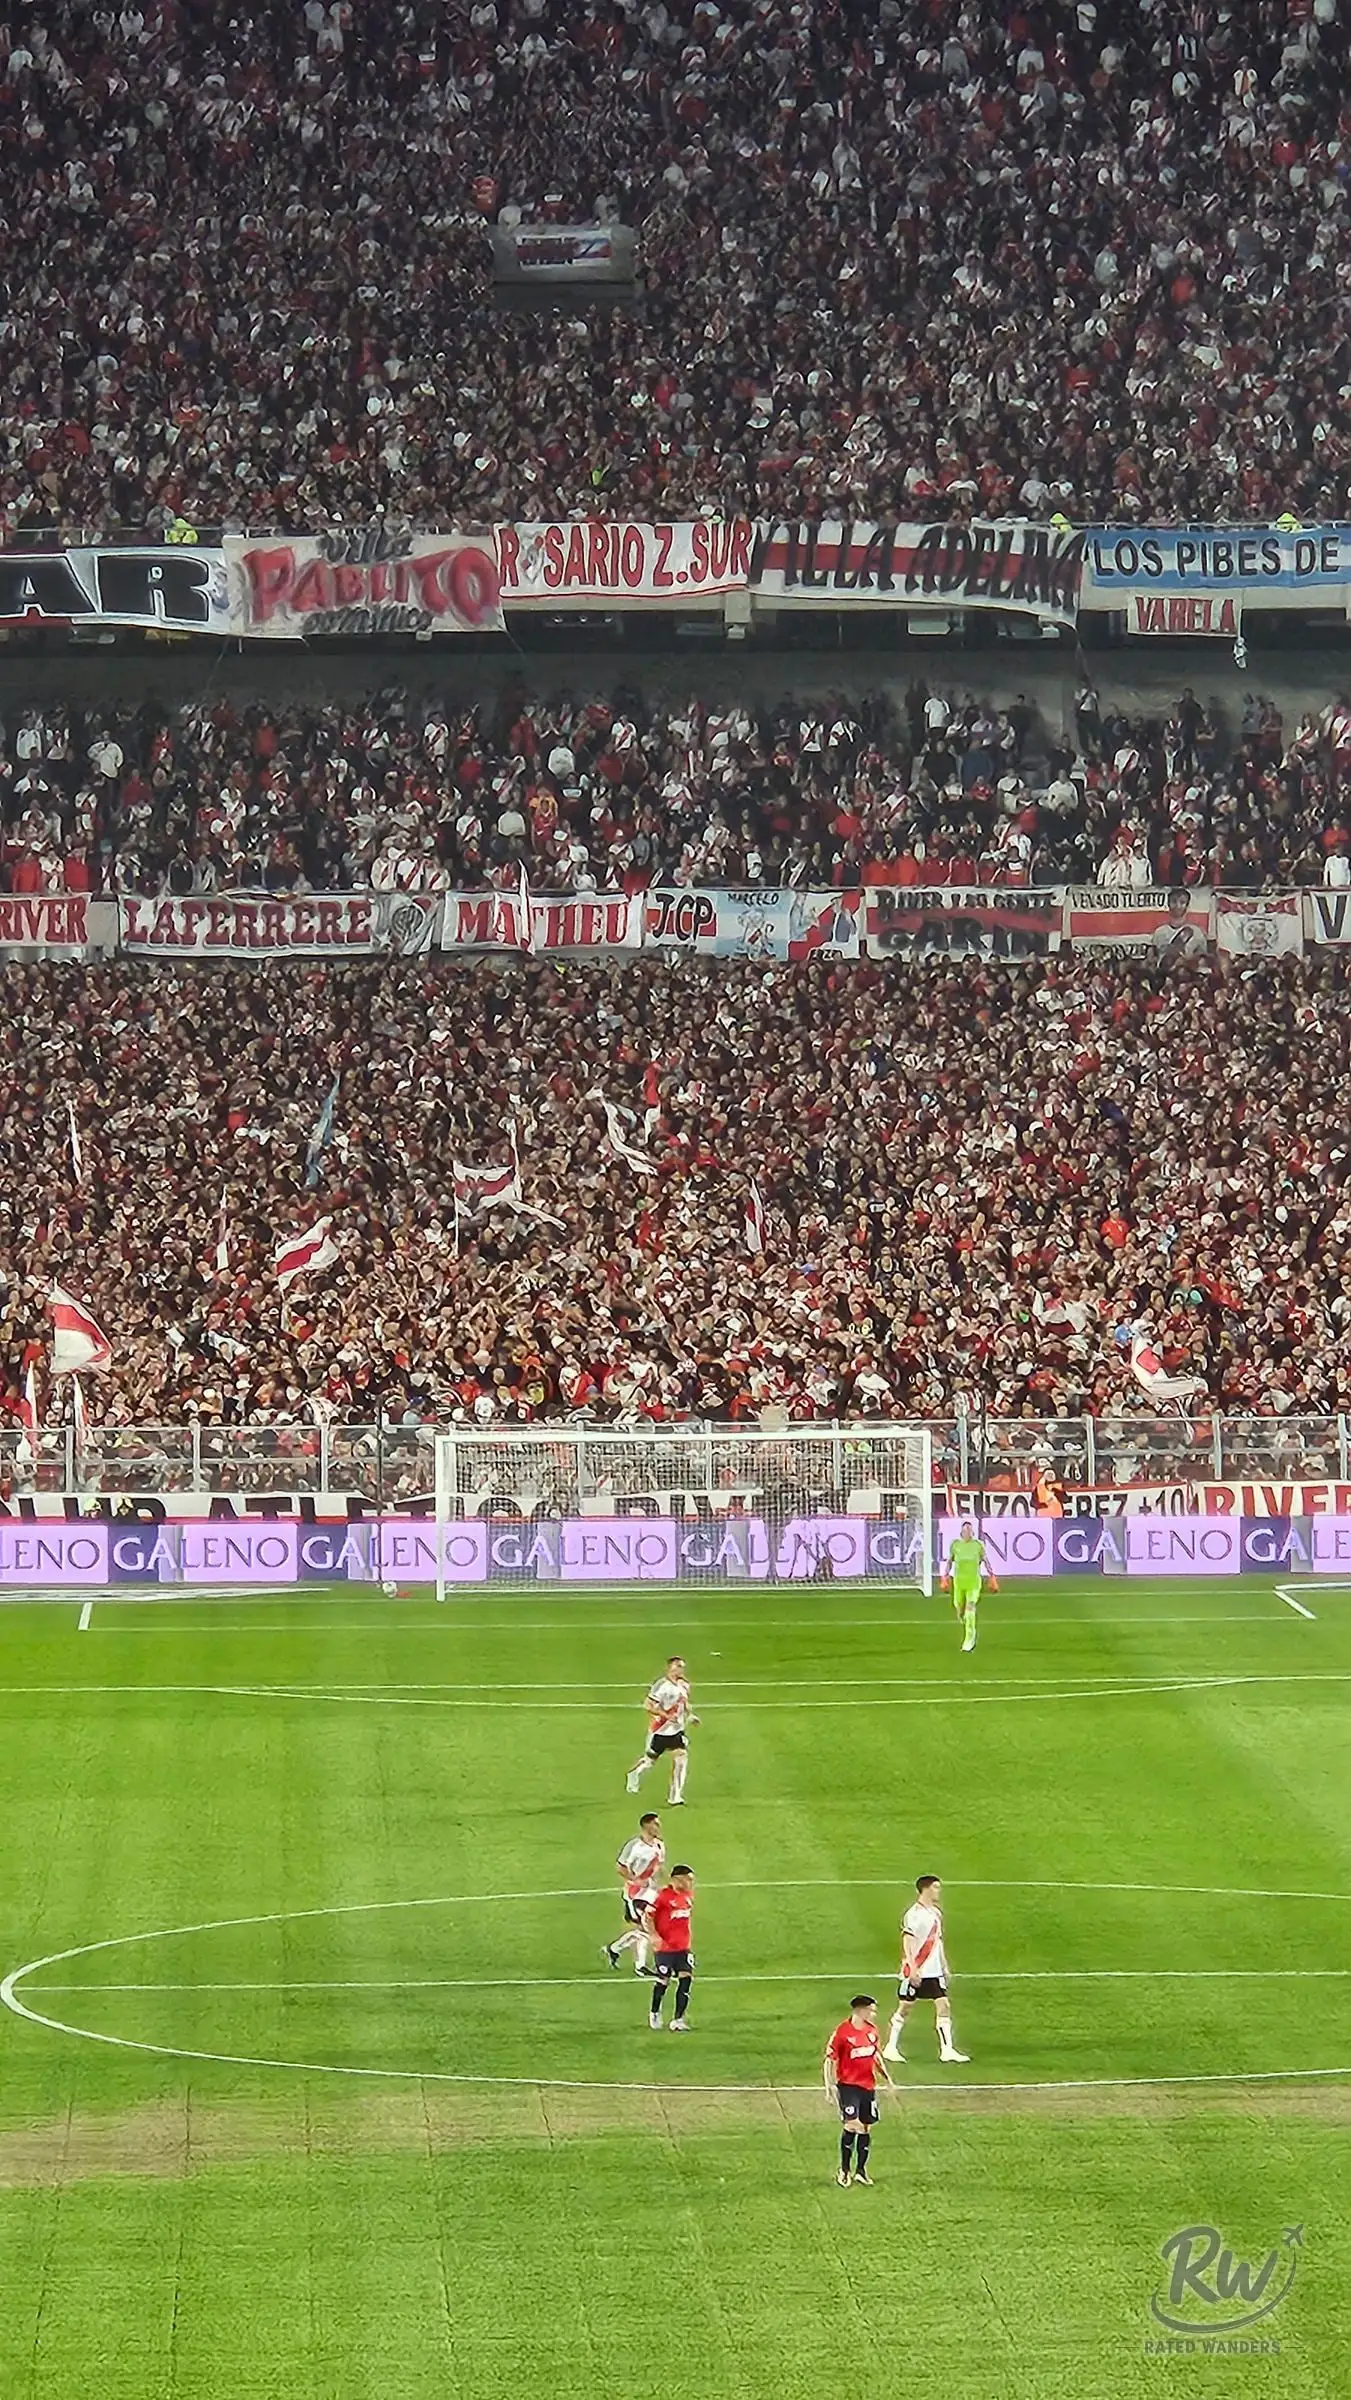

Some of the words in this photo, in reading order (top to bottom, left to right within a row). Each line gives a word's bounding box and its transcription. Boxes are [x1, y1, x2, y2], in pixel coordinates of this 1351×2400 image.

[501, 522, 644, 587] RSARIO
[1095, 538, 1163, 577] LOS
[1177, 539, 1281, 578] PIBES
[1295, 536, 1340, 575] DE
[653, 893, 713, 941] JCP
[113, 1537, 289, 1571] GALENO
[302, 1536, 478, 1569] GALENO
[492, 1534, 668, 1567] GALENO
[870, 1531, 1045, 1565] GALNO
[1057, 1529, 1232, 1563] GALENO
